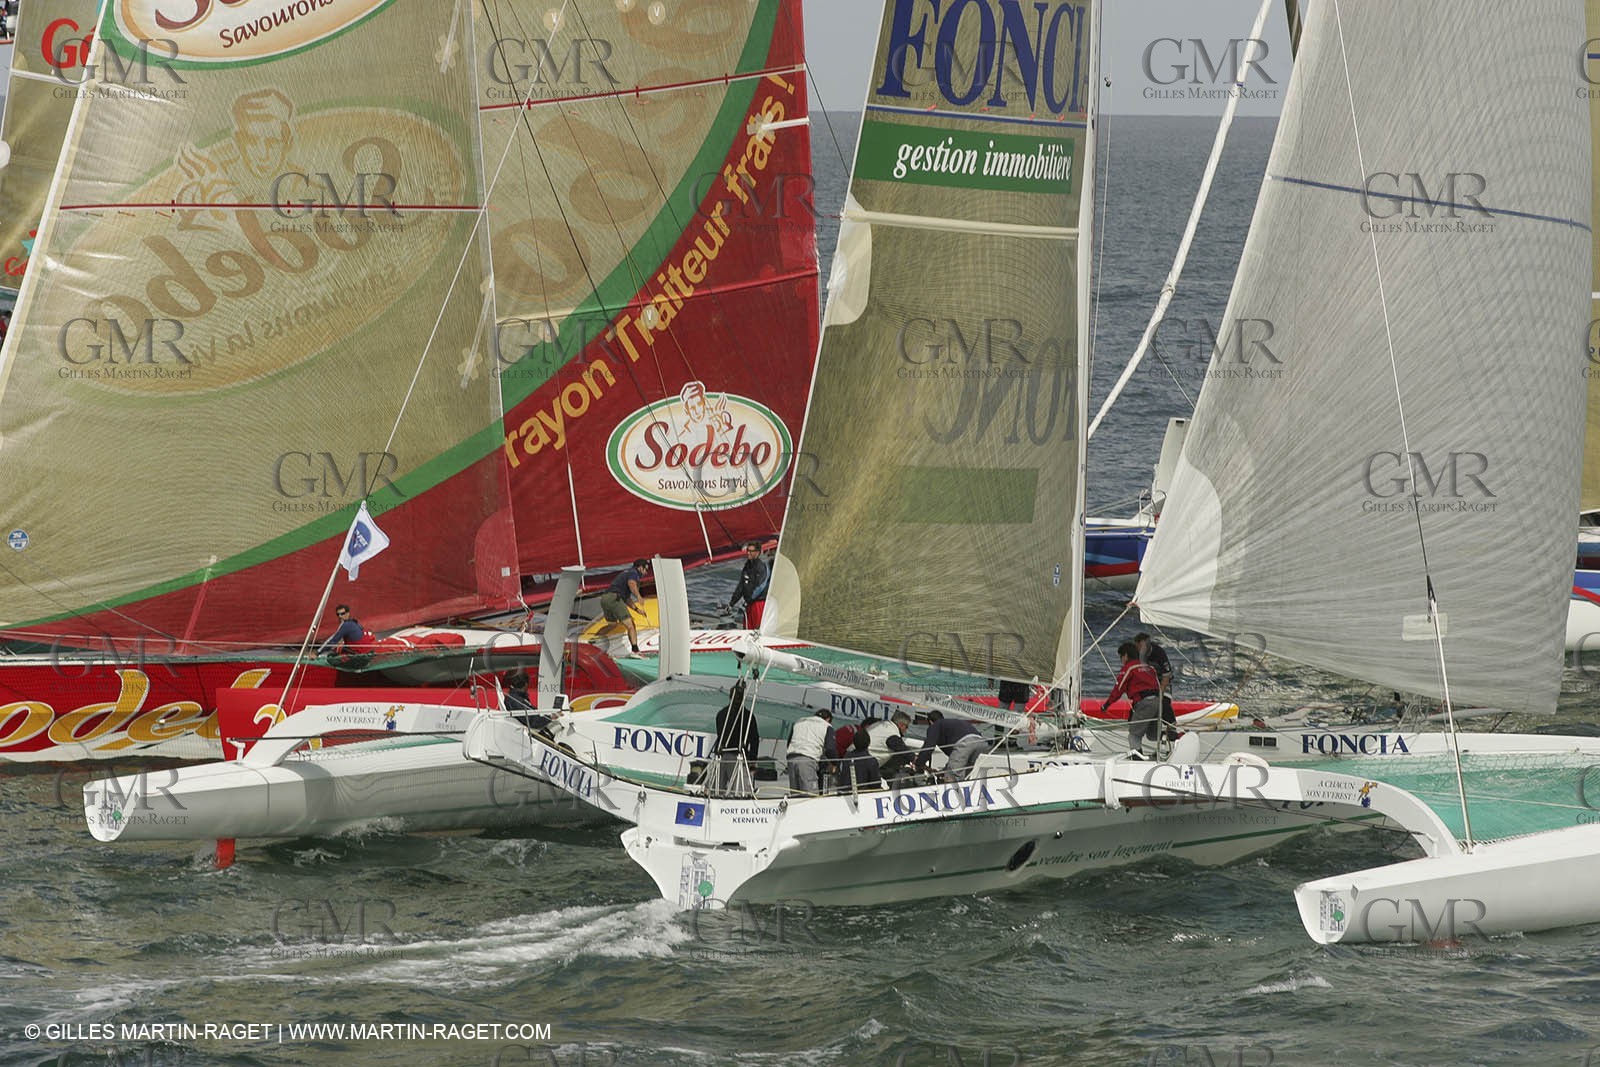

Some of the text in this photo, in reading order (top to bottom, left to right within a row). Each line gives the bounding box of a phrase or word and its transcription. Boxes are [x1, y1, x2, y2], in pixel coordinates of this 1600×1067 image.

[893, 136, 1071, 181] gestion immobilière
[504, 358, 616, 468] rayon
[605, 201, 731, 362] Traiteur
[723, 96, 786, 205] frais
[635, 421, 771, 471] Sodebo
[1301, 733, 1412, 756] FONCIA
[540, 749, 593, 798] FONCIA
[1324, 780, 1357, 789] CHACUN
[874, 784, 995, 820] FONCIA
[1305, 790, 1320, 798] SON
[1321, 791, 1352, 800] EVEREST
[1088, 850, 1110, 860] son
[1113, 840, 1174, 858] logement
